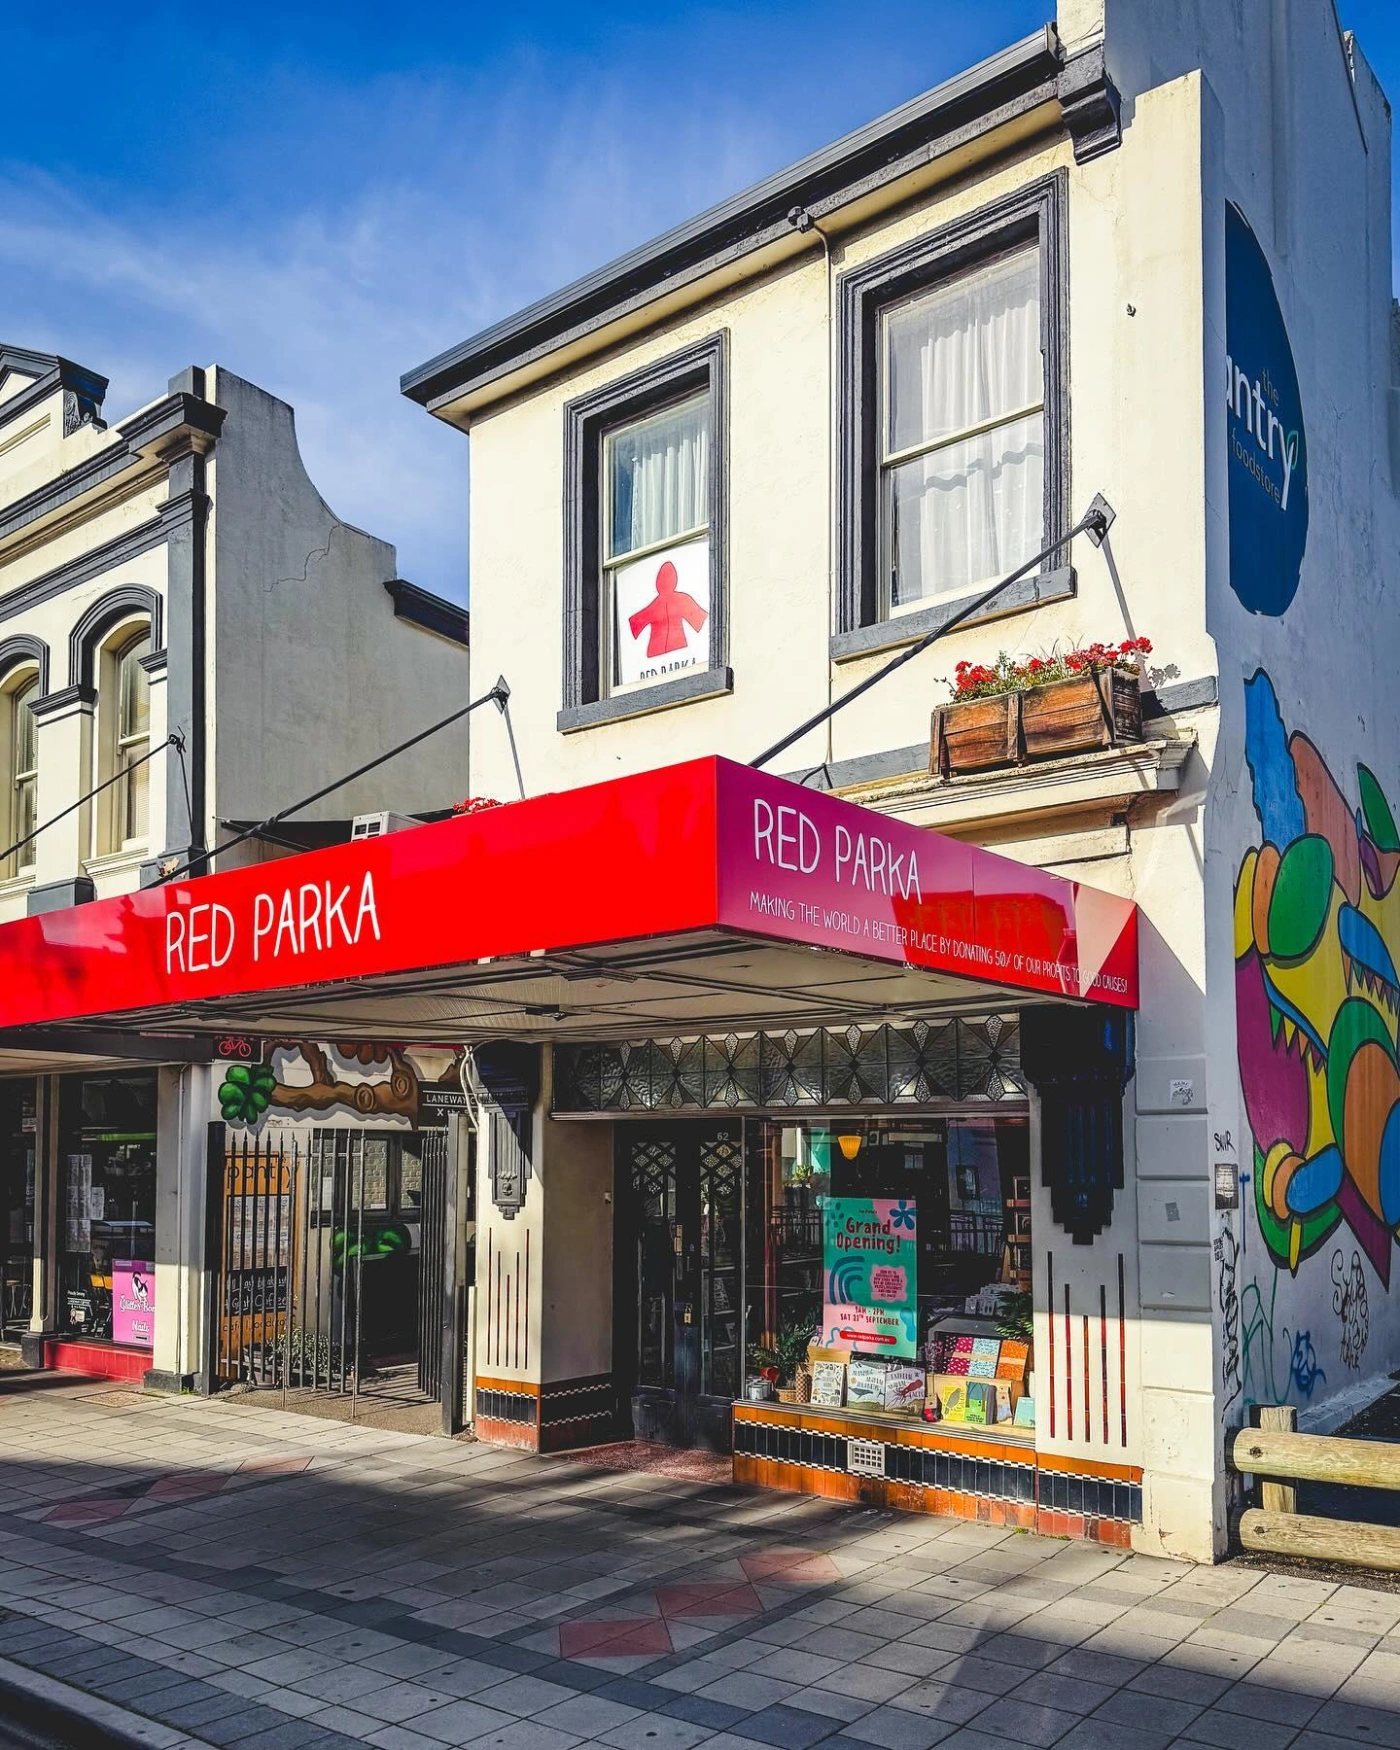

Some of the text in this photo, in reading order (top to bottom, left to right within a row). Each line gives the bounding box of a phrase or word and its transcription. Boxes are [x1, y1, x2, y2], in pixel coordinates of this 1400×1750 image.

[1232, 427, 1280, 504] foodstore
[754, 798, 922, 905] RED PARKA
[166, 870, 381, 975] RED PARKA
[750, 890, 795, 921] MAKING
[798, 902, 820, 927] THE
[823, 908, 860, 935] WORLD
[862, 918, 870, 937] A
[872, 920, 908, 946] BETTER
[910, 929, 938, 953] PLACE
[940, 936, 951, 956] BY
[952, 939, 993, 965] DONATING
[1013, 954, 1024, 971] OF
[1025, 956, 1041, 976] OUR
[1101, 974, 1128, 994] CAUSES!
[716, 1131, 729, 1142] 62
[846, 1216, 891, 1235] Grand
[836, 1231, 901, 1255] Opening!
[131, 1320, 149, 1333] Nails
[865, 1315, 900, 1326] SEPTEMBER
